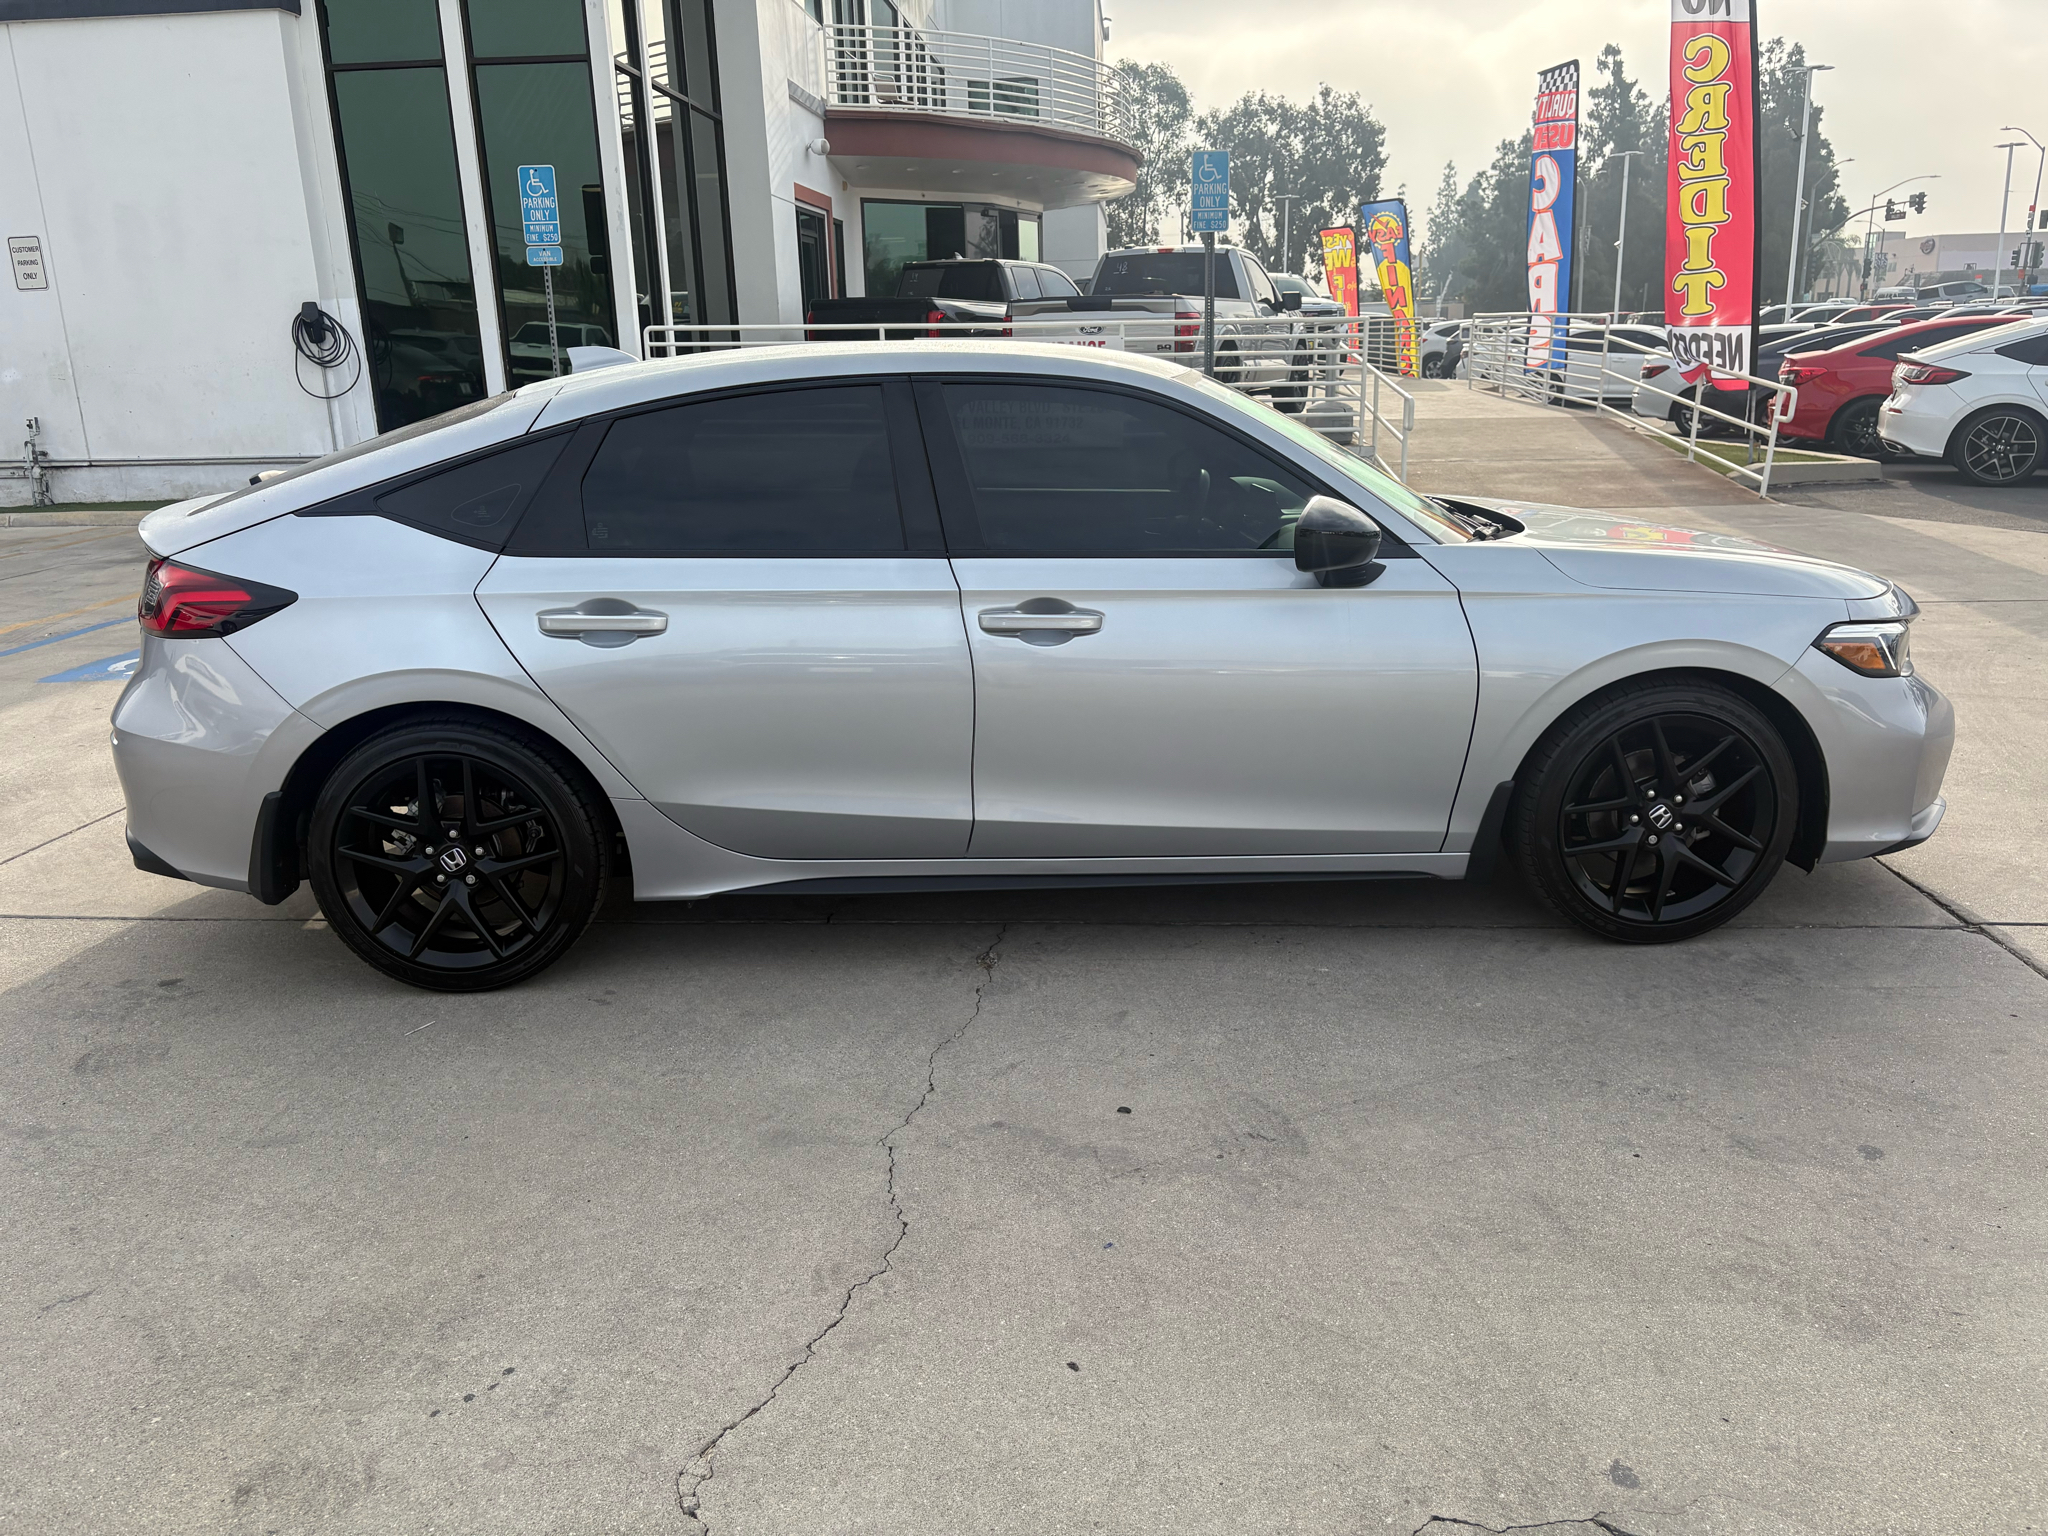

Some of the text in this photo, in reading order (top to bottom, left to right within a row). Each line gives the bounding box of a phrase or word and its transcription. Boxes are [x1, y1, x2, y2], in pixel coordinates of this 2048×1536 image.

[1194, 183, 1227, 195] PARKING
[523, 197, 555, 208] PARKING
[1200, 196, 1220, 207] ONLY
[531, 210, 549, 220] ONLY
[1194, 221, 1206, 229] FINE
[543, 233, 558, 241] $250
